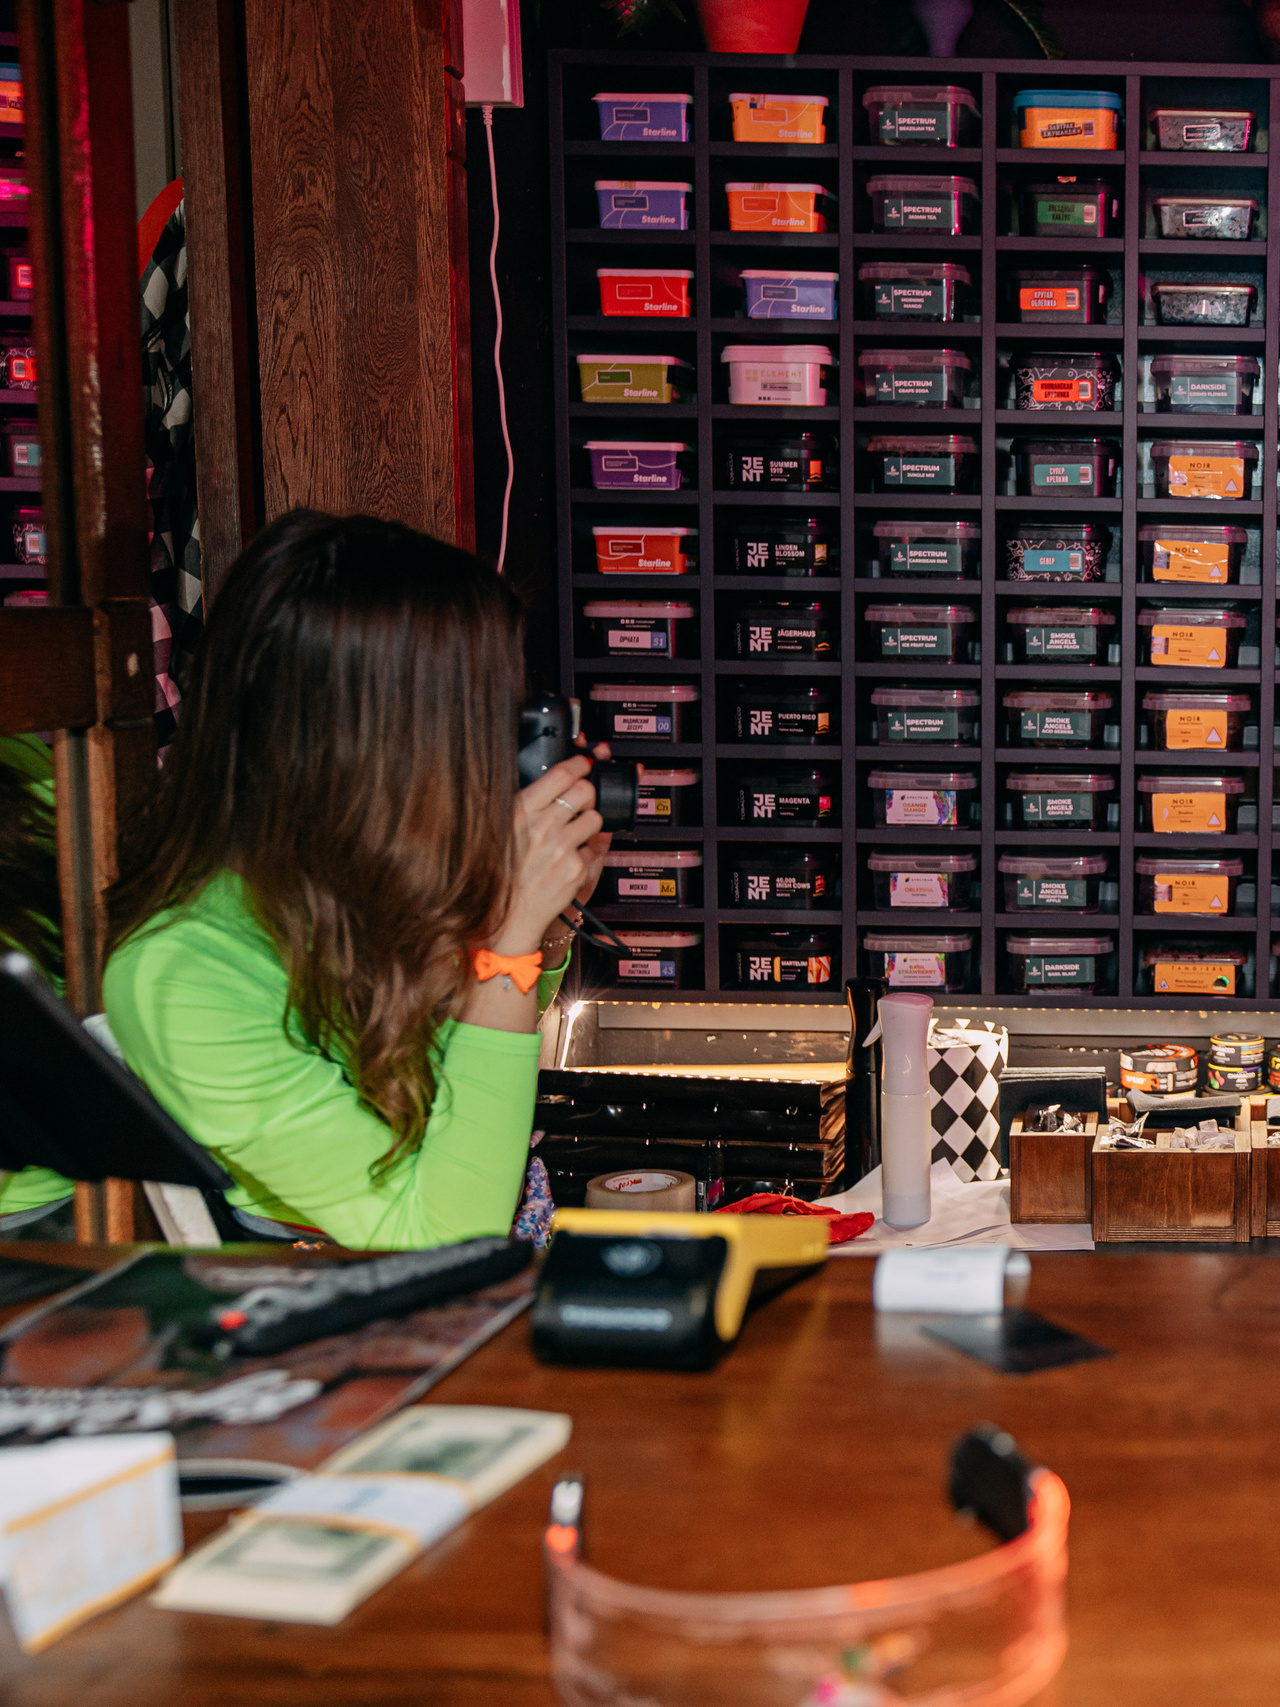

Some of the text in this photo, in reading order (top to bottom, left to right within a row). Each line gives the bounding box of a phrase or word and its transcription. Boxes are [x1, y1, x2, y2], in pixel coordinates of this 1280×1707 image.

[643, 128, 676, 136] Starline
[778, 130, 813, 138] Starline
[642, 216, 676, 224] Starline
[791, 305, 825, 313] Starline
[624, 389, 657, 397] Starline
[638, 559, 671, 567] Starline
